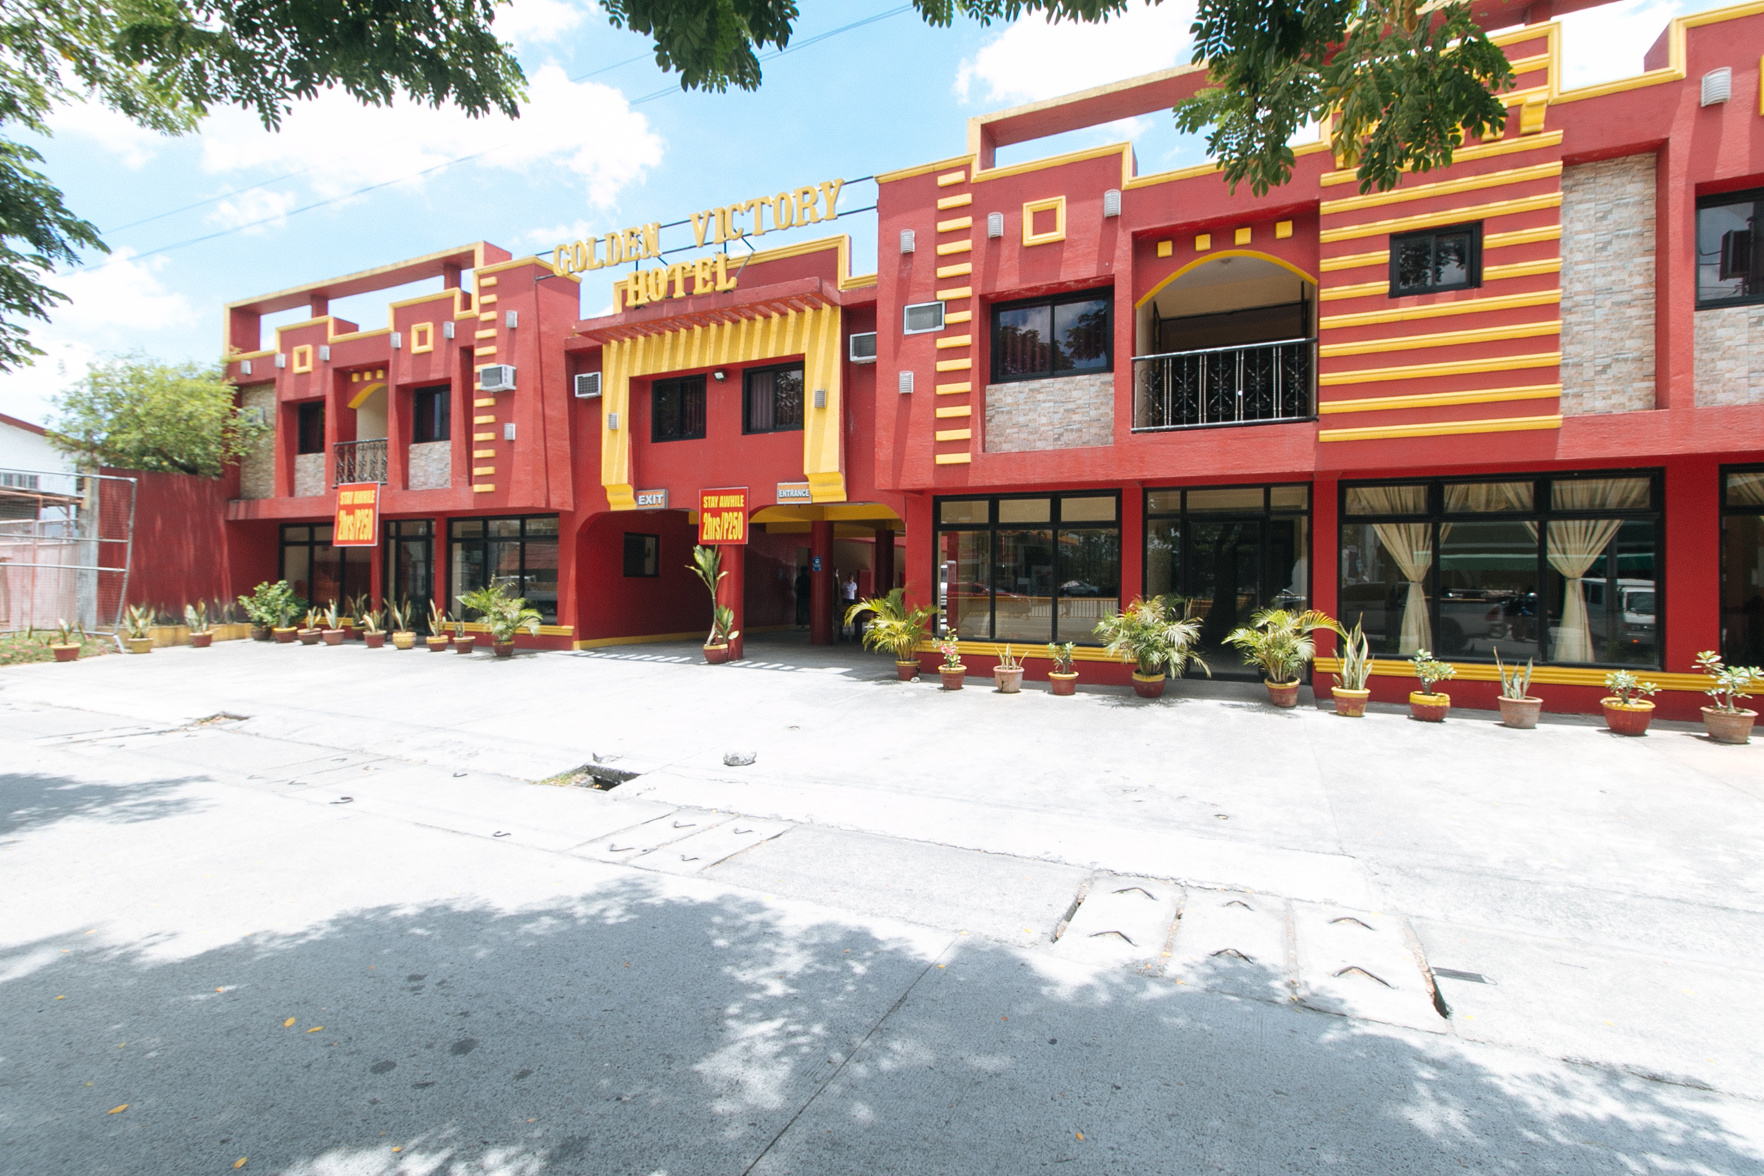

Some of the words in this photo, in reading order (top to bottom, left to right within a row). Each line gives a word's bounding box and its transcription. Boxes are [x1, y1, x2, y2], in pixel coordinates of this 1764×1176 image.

[553, 222, 661, 277] GOLDEN
[689, 178, 845, 248] VICTORY
[626, 253, 738, 307] HOTEL
[638, 494, 663, 505] EXIT
[703, 496, 719, 508] STAY
[719, 495, 744, 507] AWHILE
[778, 489, 810, 498] ENTRANCE
[703, 511, 743, 541] 2hrs/P250
